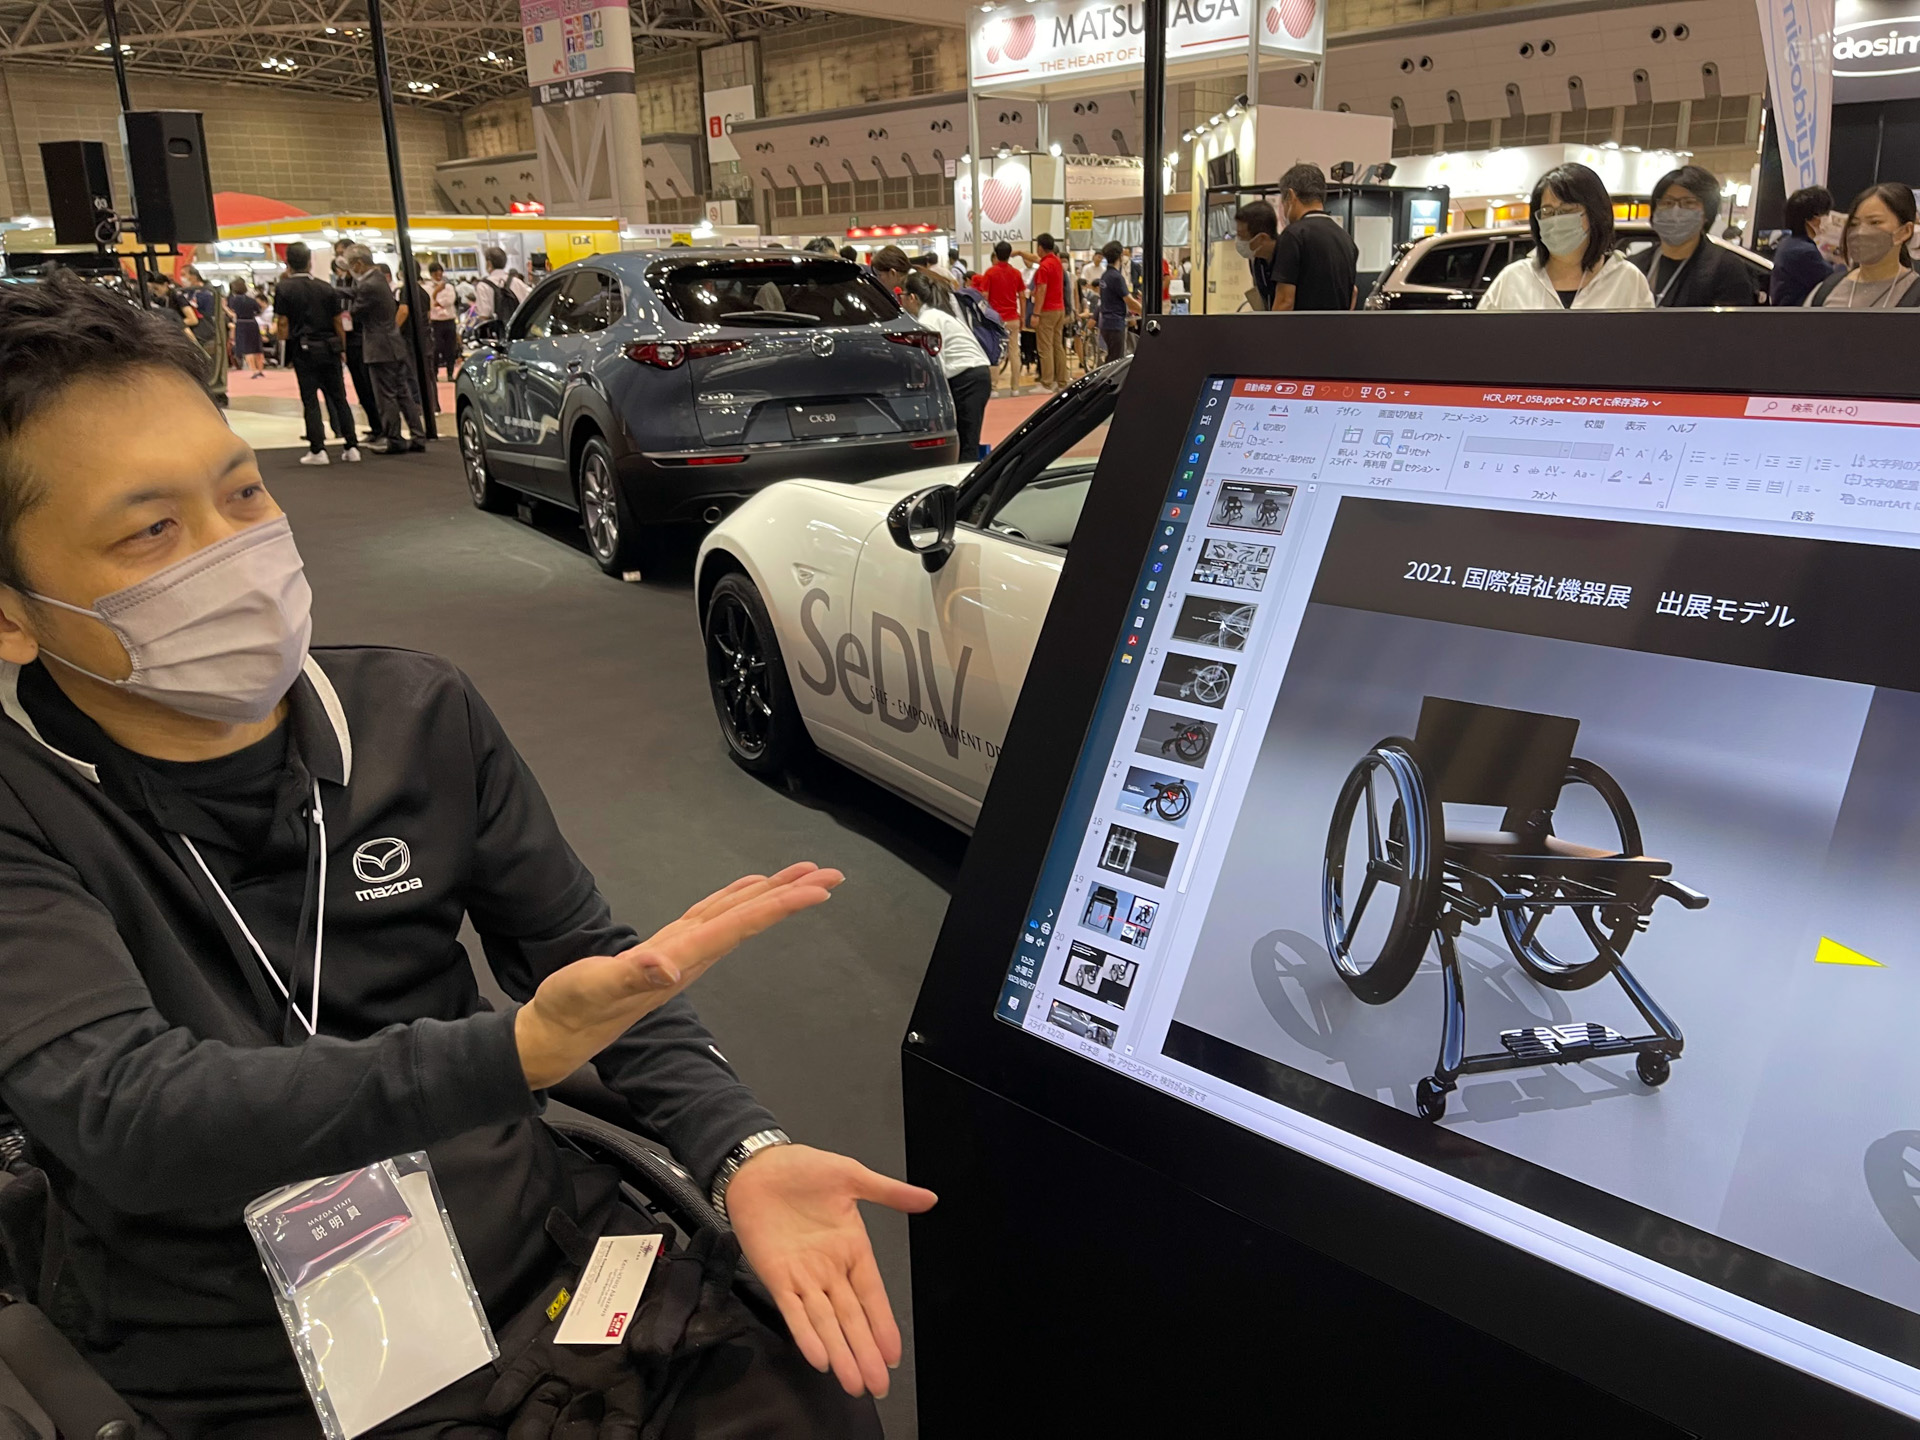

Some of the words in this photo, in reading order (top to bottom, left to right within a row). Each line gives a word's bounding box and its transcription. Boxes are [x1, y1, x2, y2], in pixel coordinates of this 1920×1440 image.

[1053, 0, 1240, 47] MATSUAGA
[1040, 61, 1065, 73] THE
[1067, 52, 1113, 71] HEART
[1117, 48, 1137, 61] OF
[963, 228, 1023, 242] MSUNAGA
[1244, 383, 1272, 393] 自動保存
[1482, 393, 1565, 406] HCR_PPT_05B.pptx
[1588, 398, 1602, 406] PC
[1234, 402, 1255, 412] ファイル
[1269, 404, 1289, 413] ホーム
[1336, 407, 1362, 416] デザイン
[1791, 403, 1814, 414] 検索
[1816, 404, 1858, 417] (Alt+Q)
[809, 413, 836, 424] CX-30
[1378, 409, 1424, 420] 画面切り替え
[1441, 412, 1489, 423] アニメーション
[1509, 415, 1539, 427] スライド
[1540, 417, 1562, 426] ショー
[1625, 420, 1647, 431] 表示
[1667, 423, 1697, 433] ヘルプ
[1413, 431, 1445, 442] レイアウト
[1337, 447, 1358, 457] 新しい
[1362, 450, 1393, 460] スライドの
[1408, 447, 1431, 457] リセット
[1328, 457, 1352, 466] スライド
[1240, 465, 1275, 476] クリップボード
[1404, 462, 1434, 473] セクション
[1368, 476, 1393, 486] スライド
[1531, 490, 1558, 500] フォント
[1856, 496, 1911, 509] SmartArt
[1186, 534, 1196, 543] 13
[1166, 590, 1177, 599] 14
[1402, 560, 1457, 586] 2021.
[1461, 565, 1633, 610] 国際福祉機器展
[1655, 589, 1797, 630] 出展モデル
[1148, 647, 1159, 656] 15
[797, 587, 973, 760] SeDV
[1129, 703, 1140, 712] 16
[870, 685, 888, 705] SELF
[897, 699, 982, 753] EMPOWERMENT
[1111, 760, 1122, 769] 17
[1093, 817, 1103, 826] 18
[1074, 874, 1084, 883] 19
[355, 877, 423, 902] mazda
[1054, 931, 1065, 941] 20
[1035, 989, 1045, 1000] 21
[307, 1209, 333, 1226] MAZDA
[311, 1205, 361, 1241] 説明員
